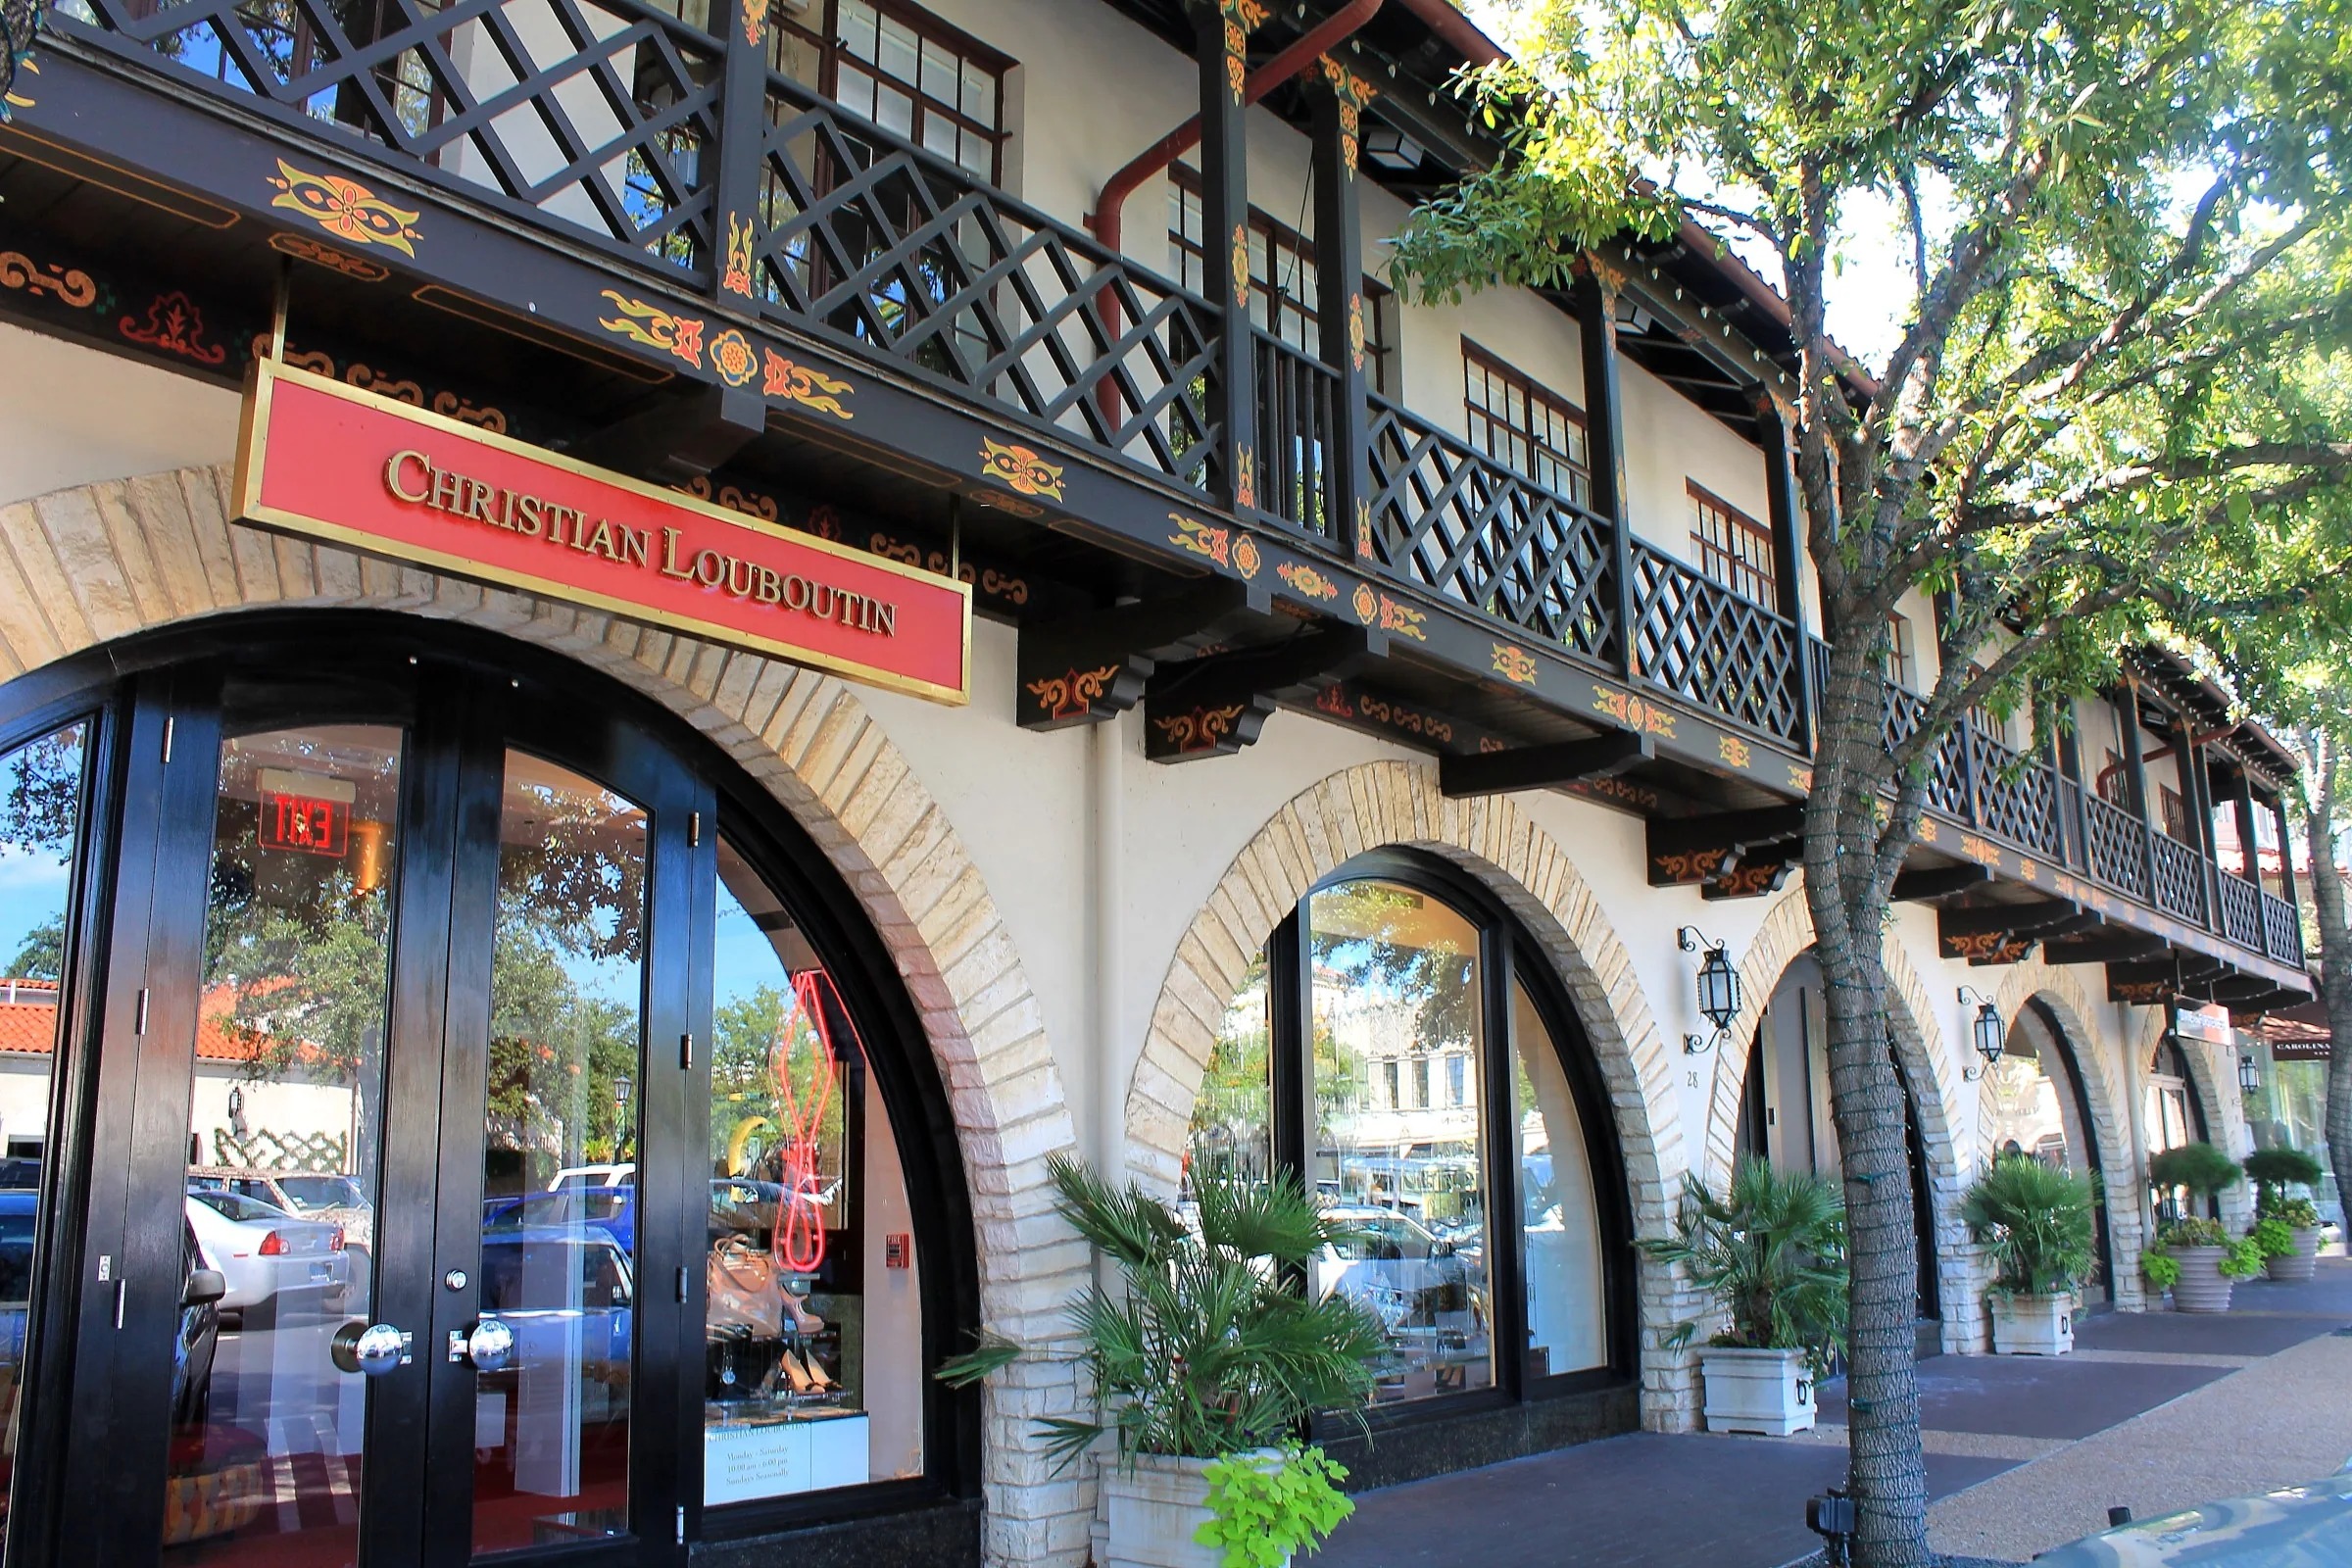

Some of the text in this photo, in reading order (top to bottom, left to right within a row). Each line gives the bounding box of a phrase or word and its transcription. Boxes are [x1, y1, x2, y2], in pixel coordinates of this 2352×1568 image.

[382, 449, 899, 638] CHRISTIAN LOUBOUTIN
[1687, 1070, 1698, 1089] 28
[709, 1429, 754, 1443] CHRISTIAN
[727, 1449, 754, 1461] Monday
[760, 1445, 789, 1455] Saturday
[777, 1458, 788, 1467] pm
[726, 1474, 754, 1486] Sundays
